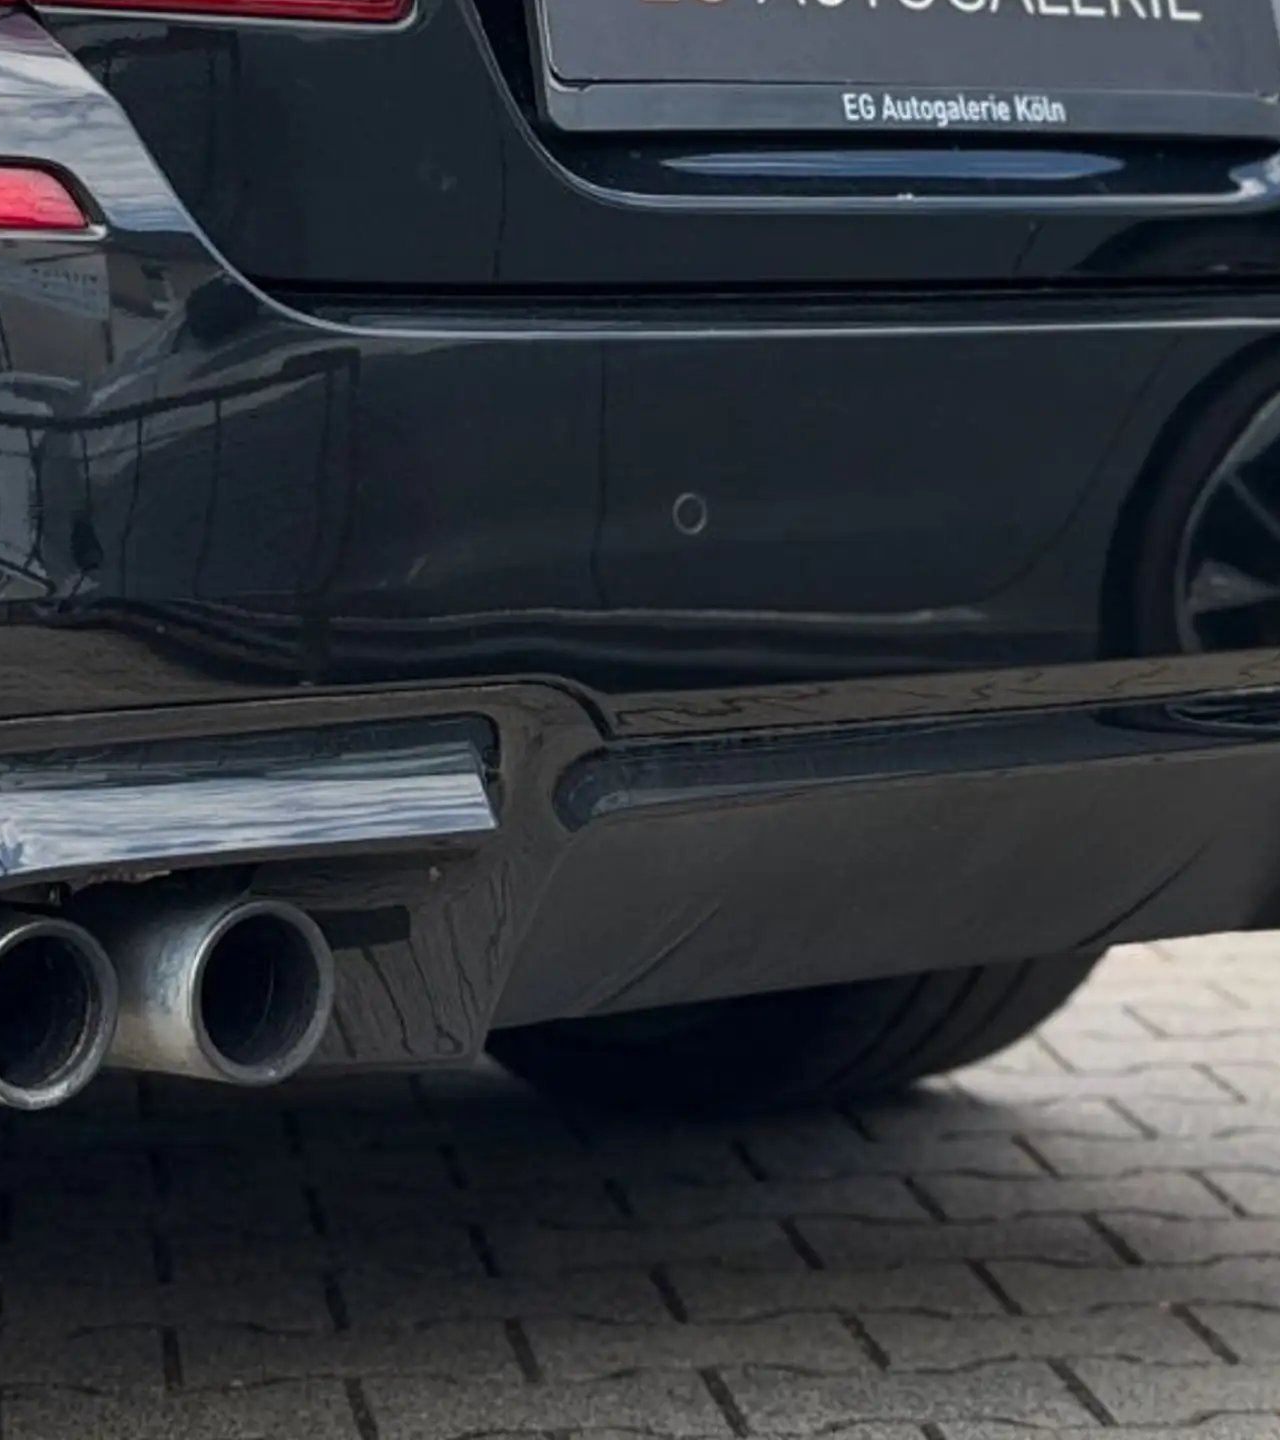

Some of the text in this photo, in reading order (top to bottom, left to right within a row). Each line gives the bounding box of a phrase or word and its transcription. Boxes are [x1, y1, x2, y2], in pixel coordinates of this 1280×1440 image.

[841, 92, 1067, 127] EG Autogalerie Köln
